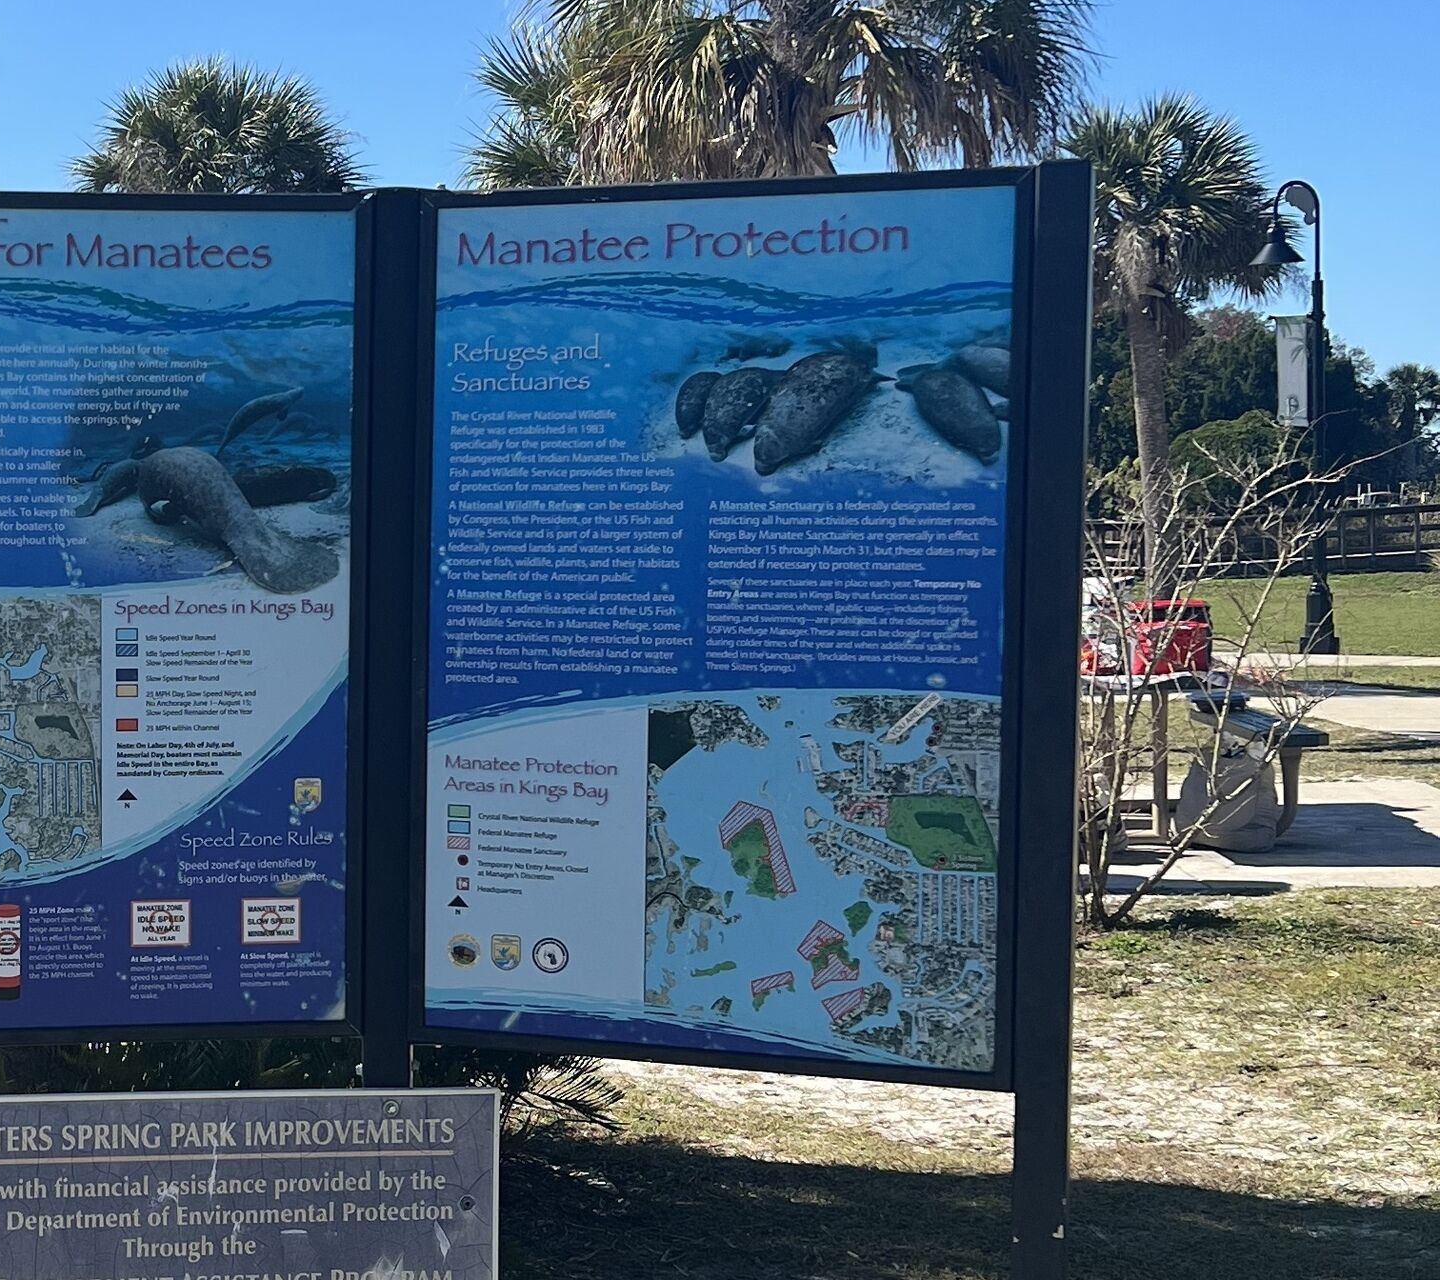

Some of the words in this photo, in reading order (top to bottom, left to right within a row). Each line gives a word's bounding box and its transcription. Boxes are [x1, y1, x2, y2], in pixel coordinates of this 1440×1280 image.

[66, 233, 272, 270] Manatees
[458, 228, 650, 266] Manatee
[665, 214, 909, 260] Protection
[454, 335, 548, 370] Refuges
[554, 332, 600, 360] and
[451, 371, 591, 392] Sanctuaries
[5, 461, 15, 470] to
[26, 461, 60, 470] smaller
[31, 447, 70, 456] increase
[114, 595, 170, 623] Speed
[174, 598, 227, 614] Zones
[232, 598, 246, 614] in
[250, 599, 296, 620] Kings
[301, 599, 334, 621] Bay
[447, 590, 454, 599] A
[456, 590, 503, 599] Manatee
[503, 590, 541, 602] Refuge
[544, 590, 552, 600] is
[562, 590, 597, 603] special
[600, 591, 650, 604] protected
[652, 594, 674, 602] area
[444, 754, 520, 772] Manatee
[526, 756, 618, 776] Protection
[444, 776, 494, 792] Areas
[500, 777, 514, 794] in
[519, 780, 567, 803] Kings
[573, 782, 609, 806] Bay
[180, 827, 234, 856] Speed
[240, 832, 282, 846] Zone
[288, 826, 333, 846] Rules
[178, 861, 208, 871] Speed
[211, 862, 237, 870] zones
[258, 859, 302, 868] identified
[304, 858, 316, 868] by
[178, 875, 203, 886] signs
[205, 873, 237, 884] and/or
[240, 873, 268, 884] buoys
[270, 873, 280, 882] in
[282, 872, 297, 882] the
[270, 917, 296, 925] SPEED
[62, 1121, 160, 1153] SPRING
[171, 1120, 236, 1151] PARK
[245, 1118, 456, 1150] IMPROVEMENTS
[55, 1175, 148, 1200] financial
[156, 1174, 266, 1198] assistance
[275, 1172, 370, 1202] provided
[379, 1171, 404, 1200] by
[412, 1170, 446, 1194] the
[7, 1204, 140, 1238] Department
[148, 1204, 168, 1229] of
[177, 1201, 333, 1229] Environmental
[343, 1199, 454, 1226] Protection
[122, 1234, 213, 1265] Through
[222, 1233, 257, 1256] the
